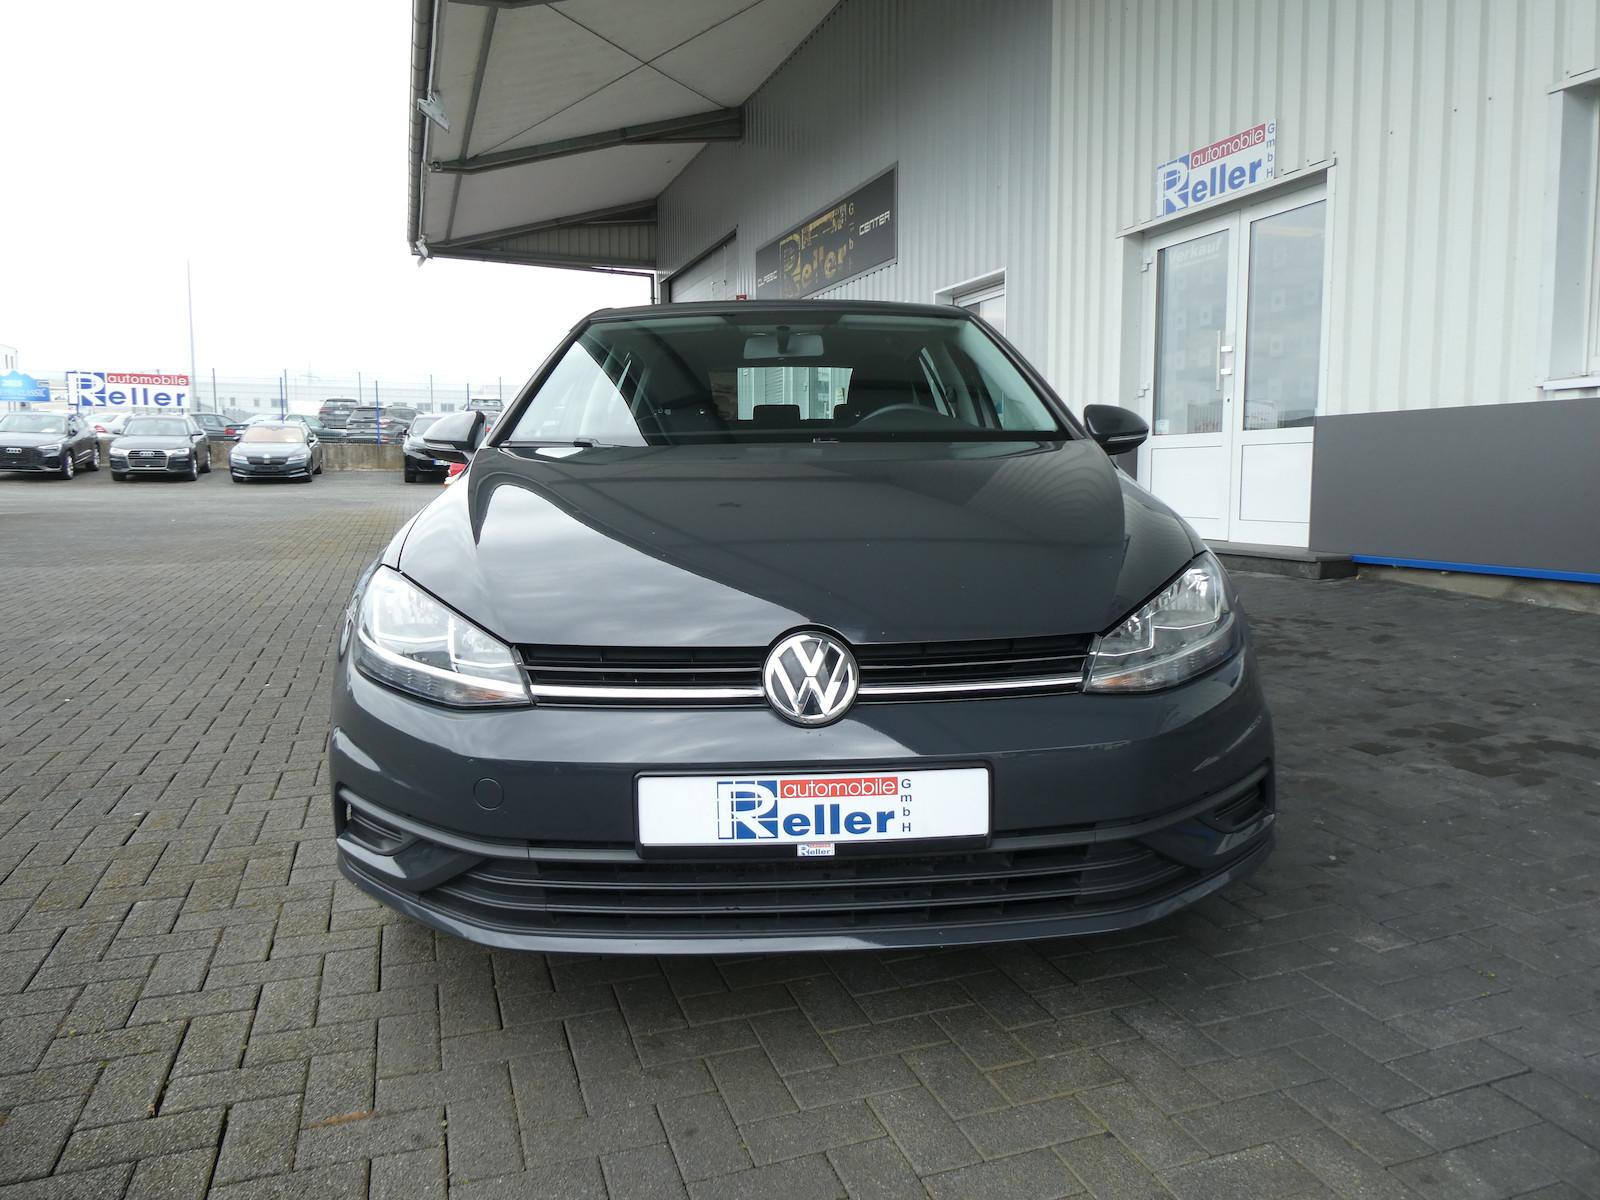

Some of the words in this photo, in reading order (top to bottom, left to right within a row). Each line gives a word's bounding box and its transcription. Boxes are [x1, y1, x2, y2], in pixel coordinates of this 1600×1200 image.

[1192, 129, 1264, 168] automobile
[1156, 154, 1262, 217] Reller
[859, 210, 891, 236] CENTER
[66, 372, 186, 407] Reller
[107, 374, 187, 385] automobile
[783, 778, 896, 797] automobile
[900, 778, 913, 833] GmbH
[716, 780, 895, 840] Reller
